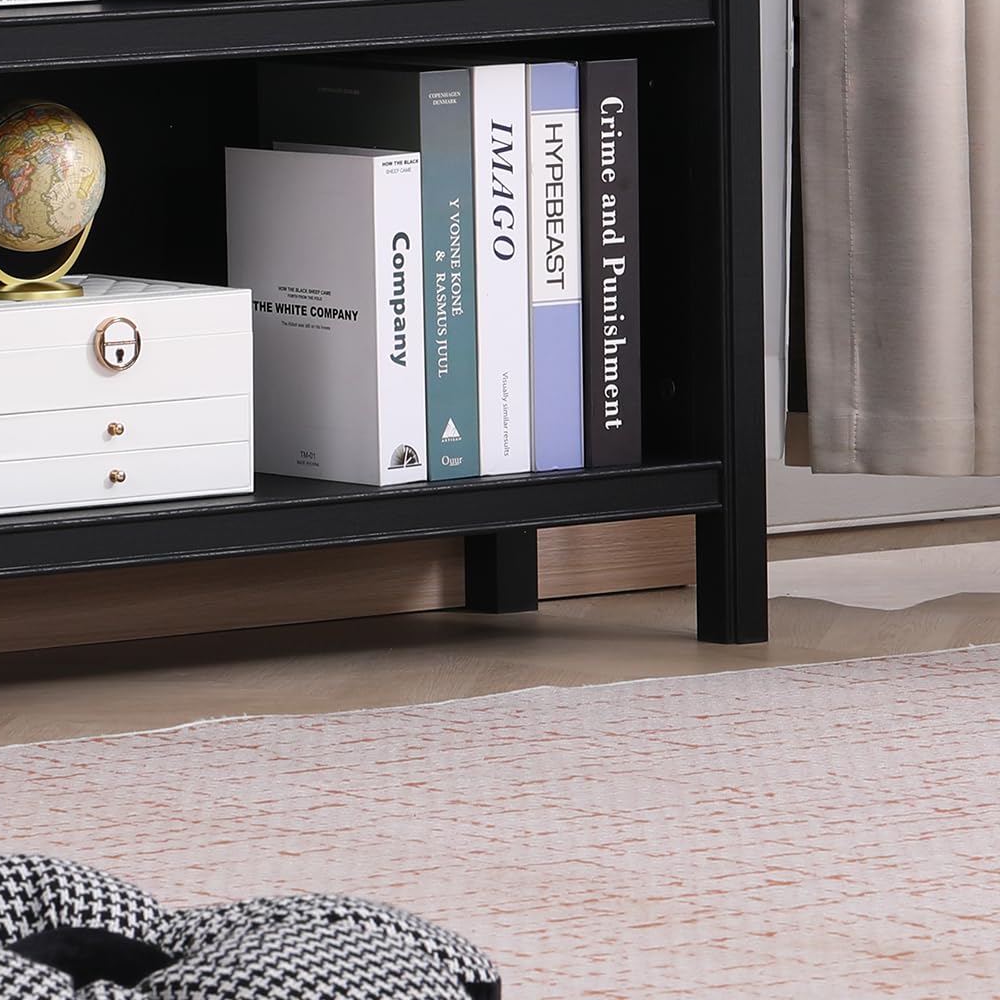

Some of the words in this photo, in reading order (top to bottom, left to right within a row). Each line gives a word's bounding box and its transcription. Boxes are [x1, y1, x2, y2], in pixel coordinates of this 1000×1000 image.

[600, 96, 624, 183] Crime
[490, 118, 516, 261] IMAGO
[545, 123, 565, 290] HYPEBEAST
[602, 193, 625, 247] and
[435, 250, 446, 262] &
[252, 300, 273, 312] THE
[275, 302, 308, 316] WHITE
[310, 306, 359, 321] COMPANY
[389, 231, 410, 367] Company
[435, 272, 448, 337] RASMUS
[436, 339, 449, 378] JUUL
[602, 255, 627, 430] Punishment
[501, 371, 509, 402] Visually
[503, 430, 511, 457] results
